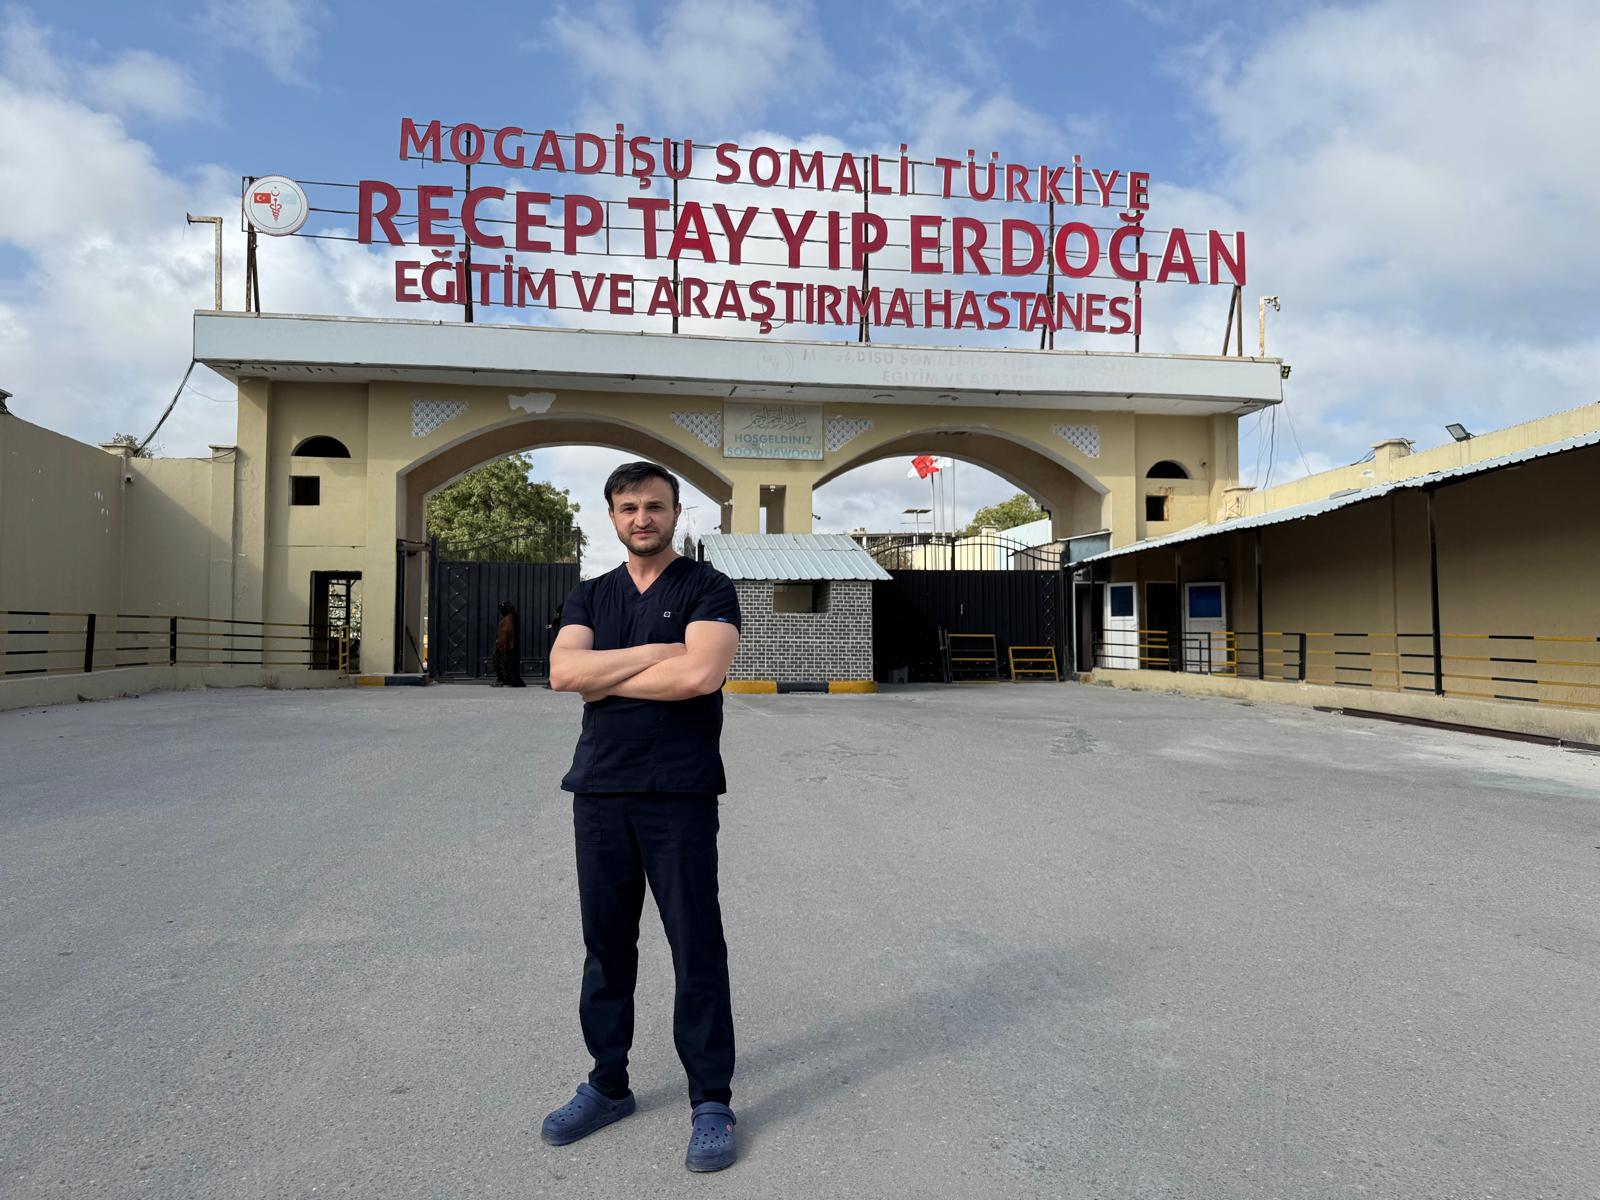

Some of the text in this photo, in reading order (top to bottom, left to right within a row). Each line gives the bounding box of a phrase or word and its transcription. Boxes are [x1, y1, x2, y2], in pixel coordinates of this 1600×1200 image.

[400, 117, 1150, 210] MOGADİŞU SOMALİ TÜRKİYE
[358, 180, 1246, 286] RECEP TAYYIP ERDOĞAN
[395, 249, 1142, 336] EĞİTİM VE ARAŞTIRMA HASTANESİ
